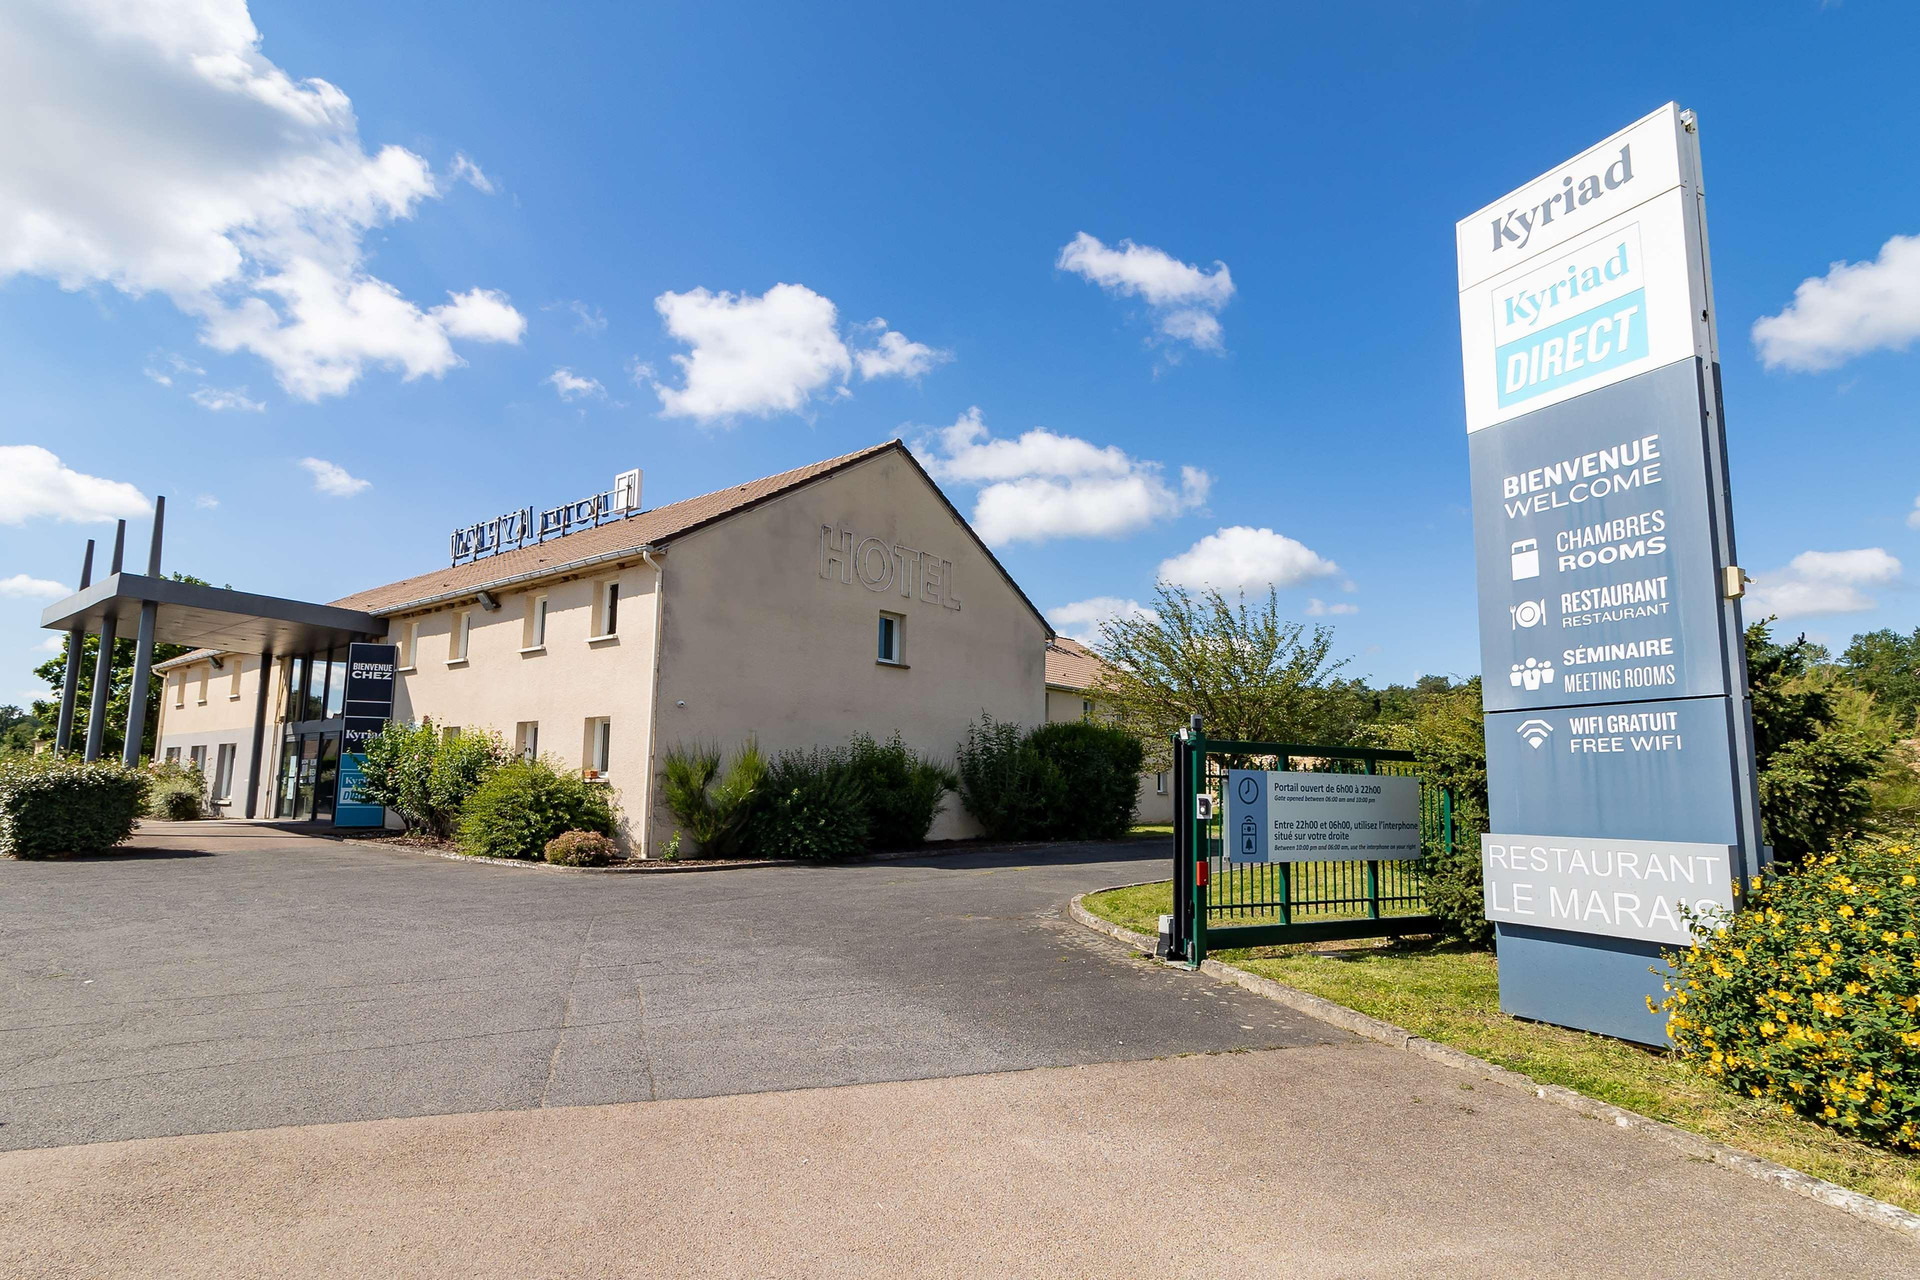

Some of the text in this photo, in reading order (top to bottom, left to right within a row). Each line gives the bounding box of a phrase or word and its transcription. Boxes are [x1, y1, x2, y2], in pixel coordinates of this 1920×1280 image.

[1490, 143, 1634, 253] Kyriad
[1504, 242, 1630, 327] Kyriad
[1504, 304, 1639, 396] DIRECT
[1503, 434, 1661, 499] BIENVENUE
[1504, 463, 1662, 519] WELCOME
[1556, 509, 1666, 553] CHAMBRES
[820, 524, 962, 611] HOTEL
[1558, 536, 1667, 572] ROOMS
[1561, 576, 1668, 614] RESTAURANT
[1562, 602, 1670, 629] RESTAURANT
[352, 662, 393, 672] BIENVENUE
[1563, 638, 1674, 666] SÉMINAIRE
[352, 671, 392, 680] CHEZ
[1564, 664, 1676, 693] MEETING ROOMS
[1569, 712, 1678, 735] WIFI GRATUIT
[1570, 735, 1682, 753] FREE WIFI
[1274, 782, 1382, 794] Portail ouvert de 6h00 à 22h00
[1274, 820, 1418, 831] Entre 22h00 et 06h00, utilisez l'interphone
[1274, 831, 1293, 840] situé
[1307, 832, 1327, 840] votre
[1328, 831, 1350, 840] droite
[1488, 844, 1720, 885] RESTAURANT
[1491, 881, 1535, 915] LE
